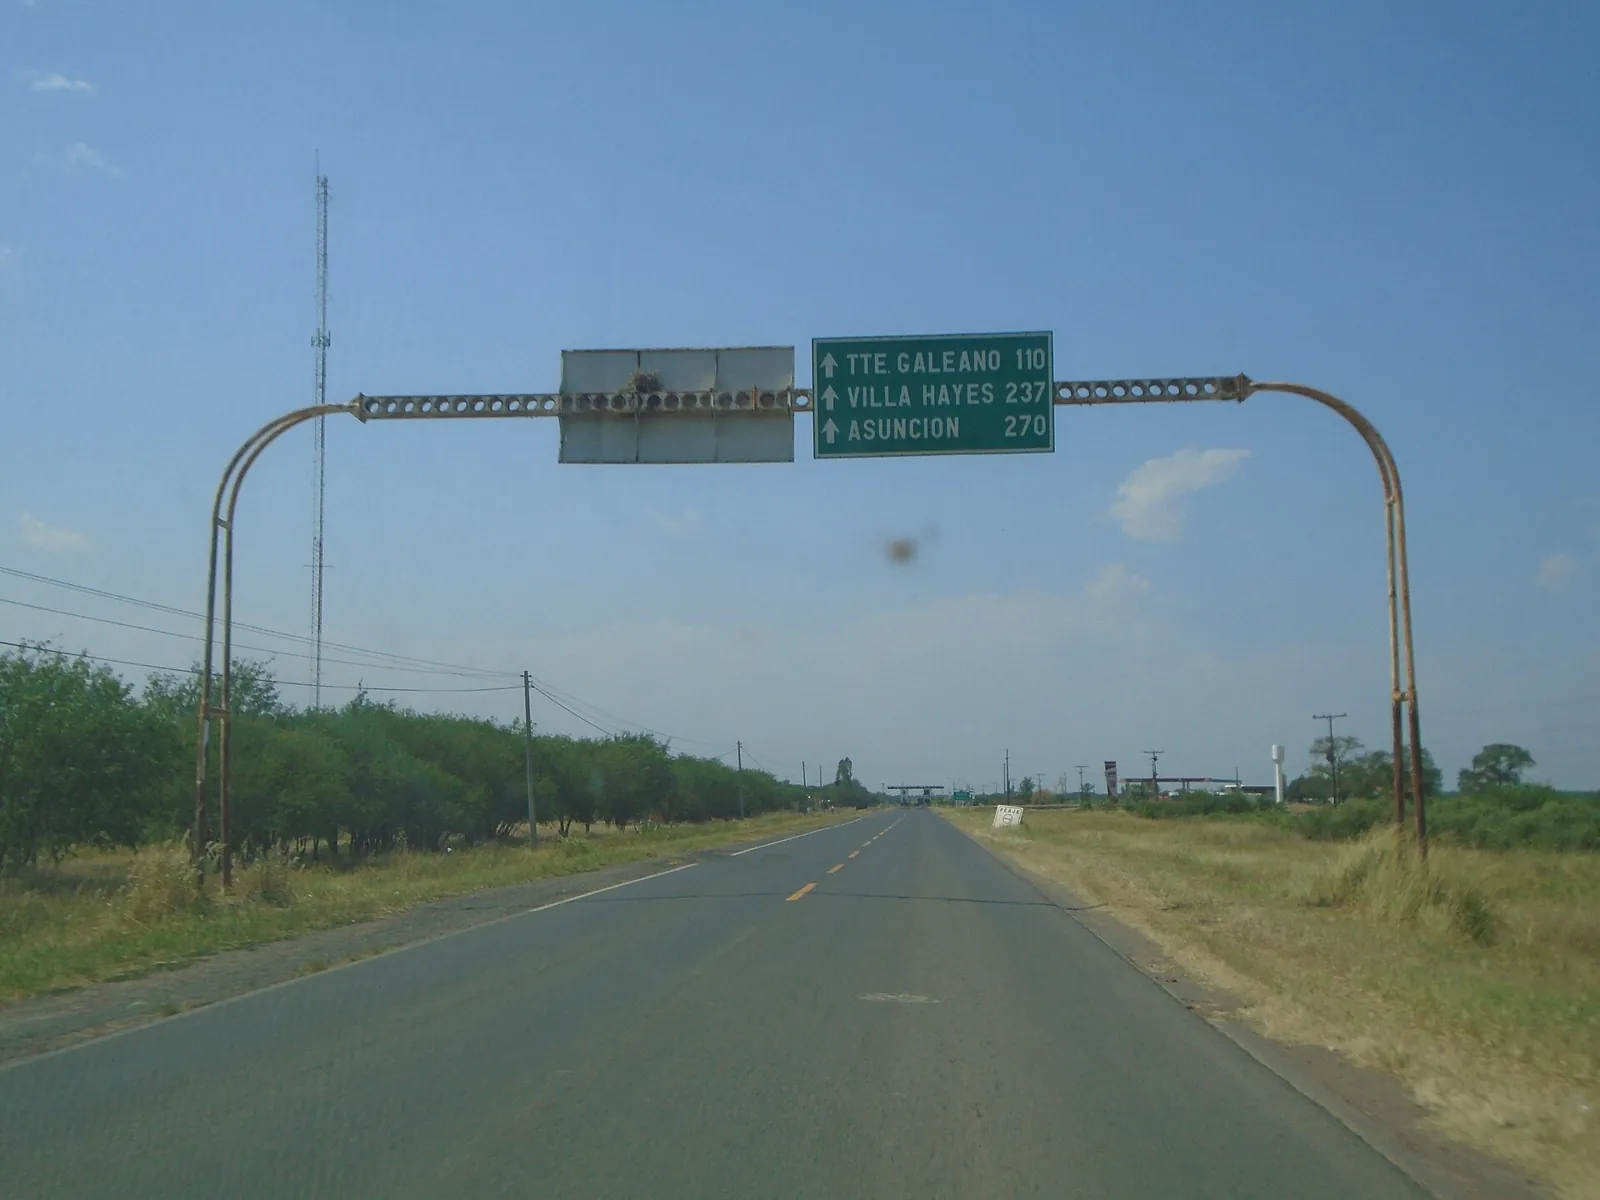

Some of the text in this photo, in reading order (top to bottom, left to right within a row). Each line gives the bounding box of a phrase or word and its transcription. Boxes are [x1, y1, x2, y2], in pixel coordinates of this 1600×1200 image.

[846, 348, 1046, 375] TTE. GALEANO 110
[847, 381, 1046, 408] VILLA HAYES 237
[848, 414, 1047, 441] ASUNCION 270
